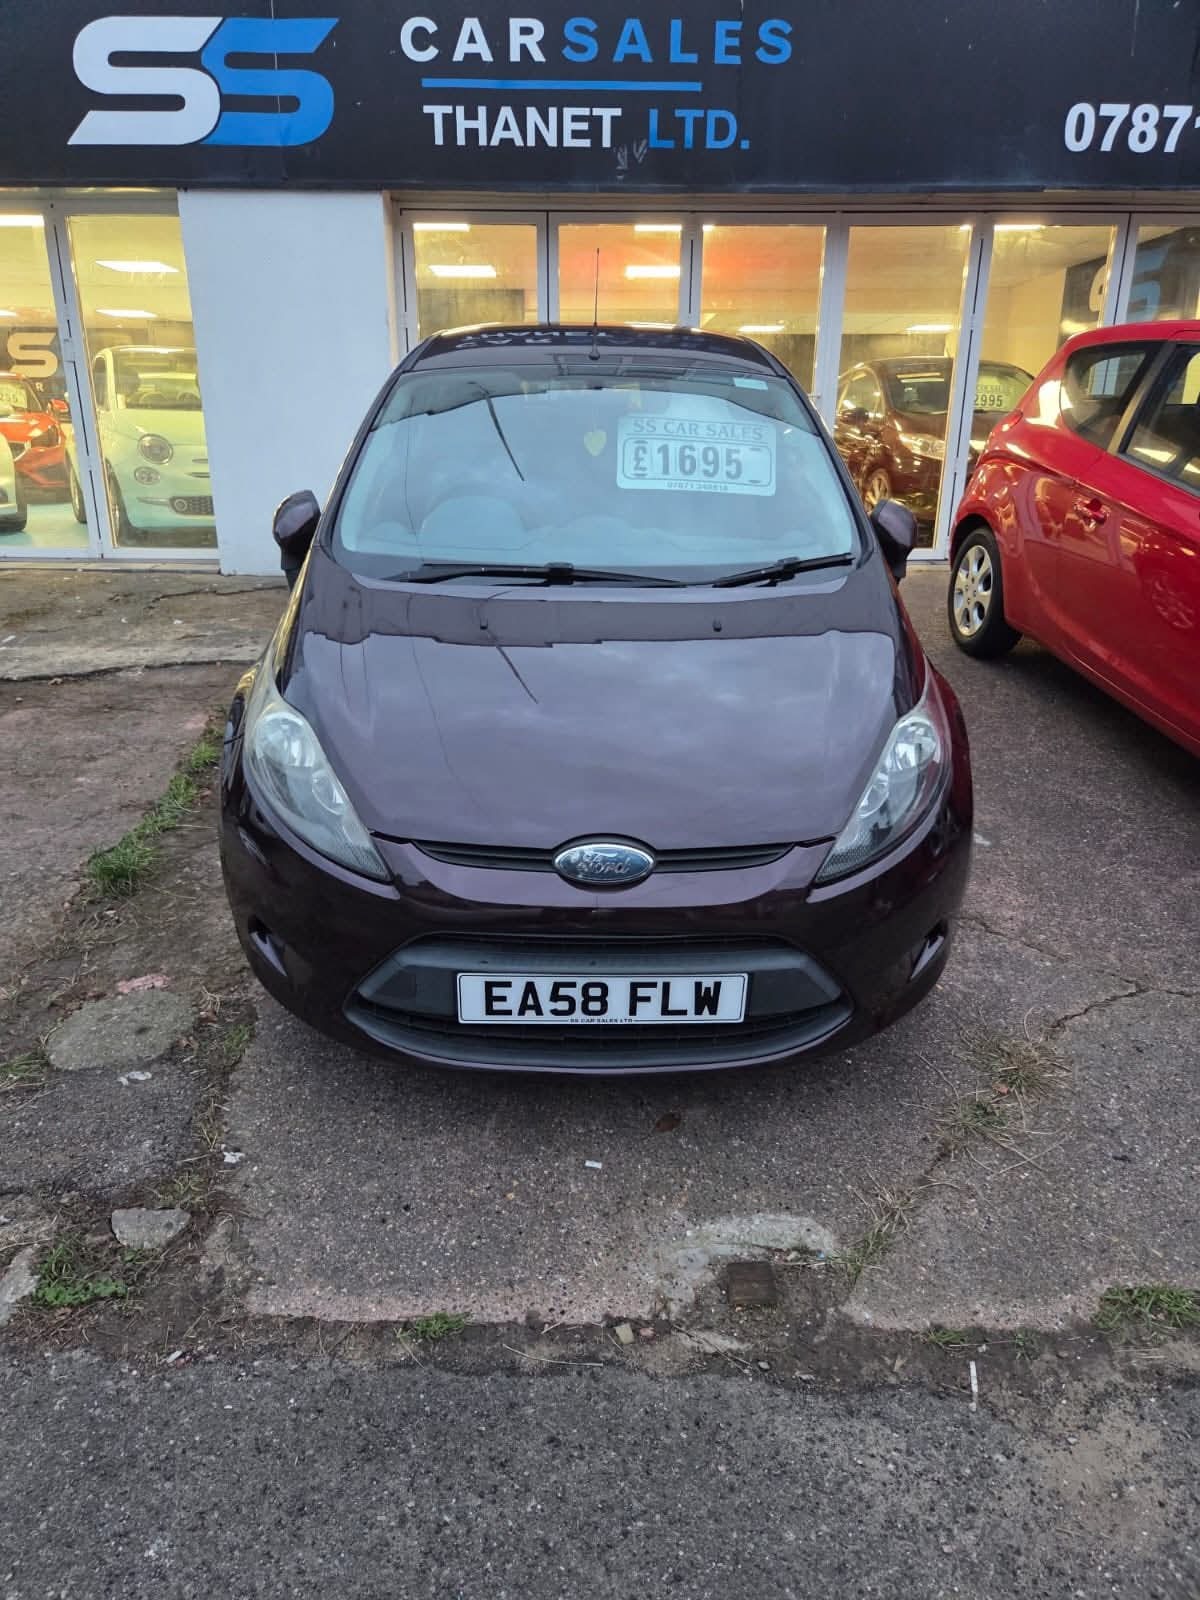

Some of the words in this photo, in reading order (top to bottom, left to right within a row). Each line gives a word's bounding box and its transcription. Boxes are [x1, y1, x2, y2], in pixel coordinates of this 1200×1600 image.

[67, 16, 339, 146] SS
[422, 105, 622, 148] THANET
[648, 108, 750, 149] LTD.
[1064, 102, 1200, 153] 0787
[633, 420, 657, 433] SS
[663, 423, 699, 435] CAR
[706, 425, 763, 440] SALES
[576, 852, 631, 874] Ford
[484, 981, 609, 1017] EA58
[629, 981, 722, 1017] FLW
